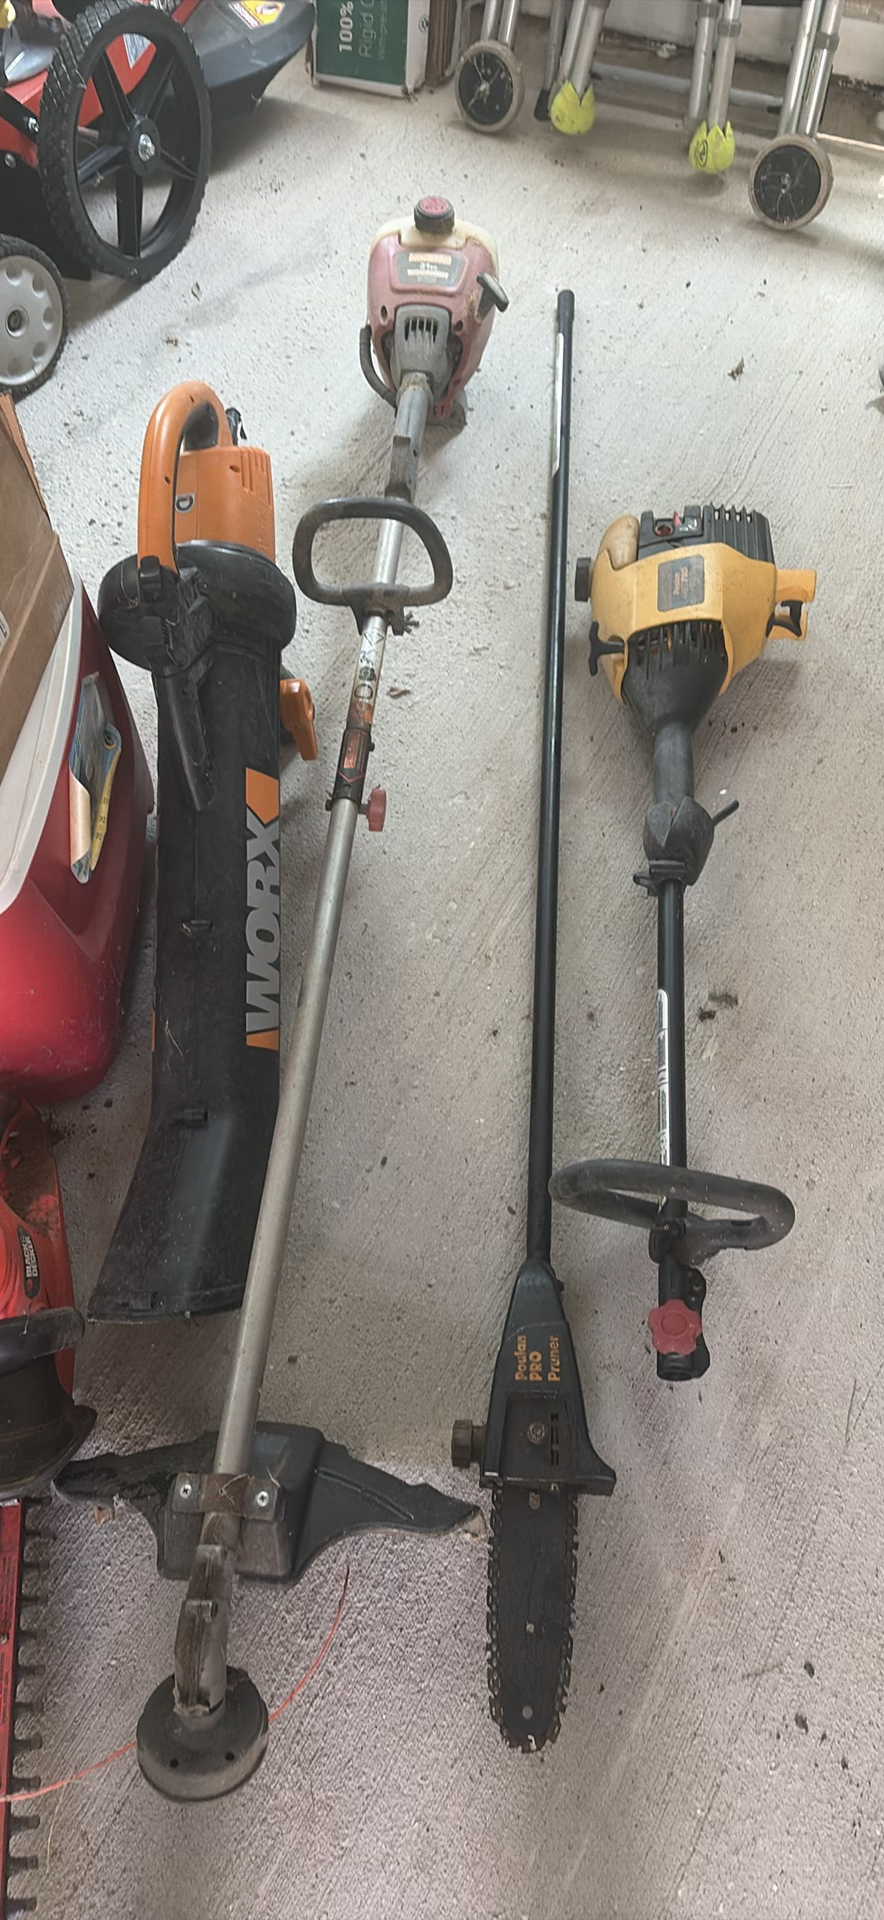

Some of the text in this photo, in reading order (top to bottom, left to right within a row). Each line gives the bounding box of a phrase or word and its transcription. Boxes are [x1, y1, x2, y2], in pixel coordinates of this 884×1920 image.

[339, 1, 354, 53] 100%
[359, 12, 377, 58] Rigid
[246, 807, 280, 1032] WORX
[23, 1242, 32, 1277] BLACK
[25, 1236, 38, 1277] DECKER
[514, 1335, 528, 1381] Poulan
[529, 1351, 543, 1381] PRO
[547, 1335, 561, 1382] Pruner
